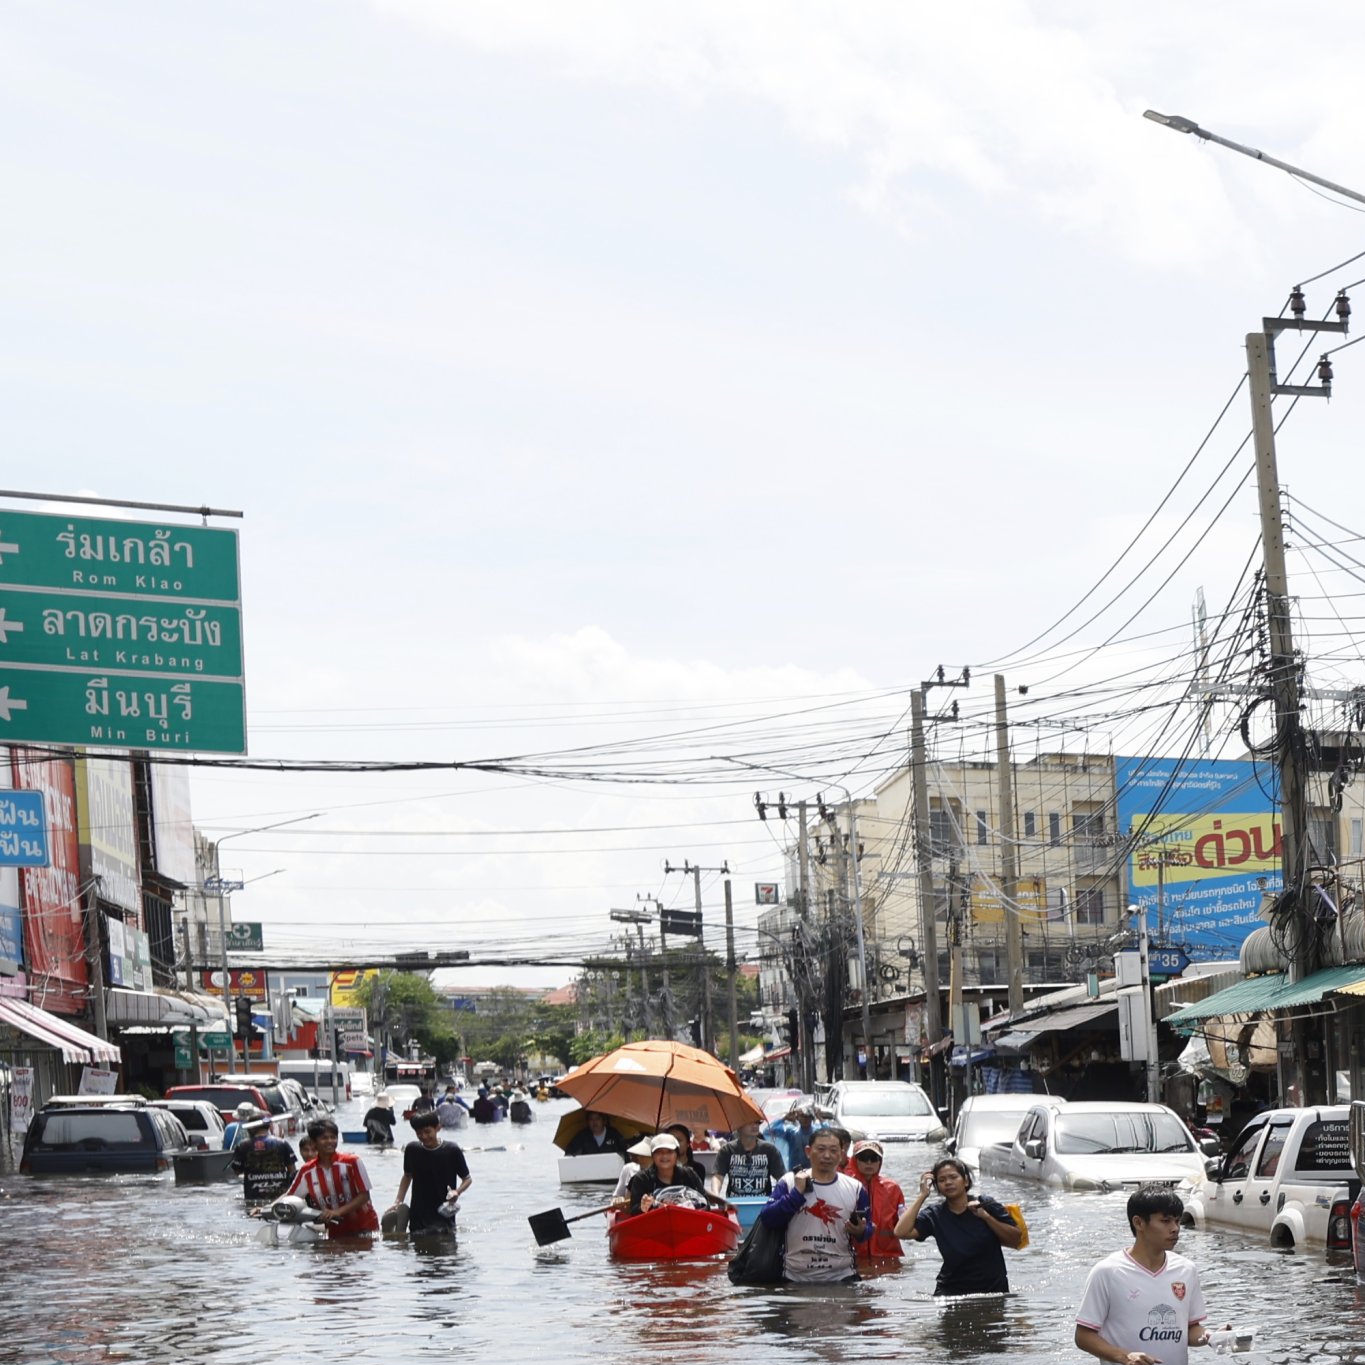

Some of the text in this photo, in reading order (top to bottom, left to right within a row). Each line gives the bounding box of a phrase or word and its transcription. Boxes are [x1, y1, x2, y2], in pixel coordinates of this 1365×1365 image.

[56, 524, 194, 568] ร่มเกล้า
[72, 570, 183, 591] Rom Klao
[42, 608, 222, 647] ลาดกระบัง
[66, 647, 205, 671] Lat Krabang
[85, 678, 192, 729] มีนบุรี
[90, 726, 191, 744] Min Buri
[1194, 820, 1283, 868] ด่วน
[1161, 954, 1180, 968] 35
[1138, 1326, 1183, 1344] Chang
